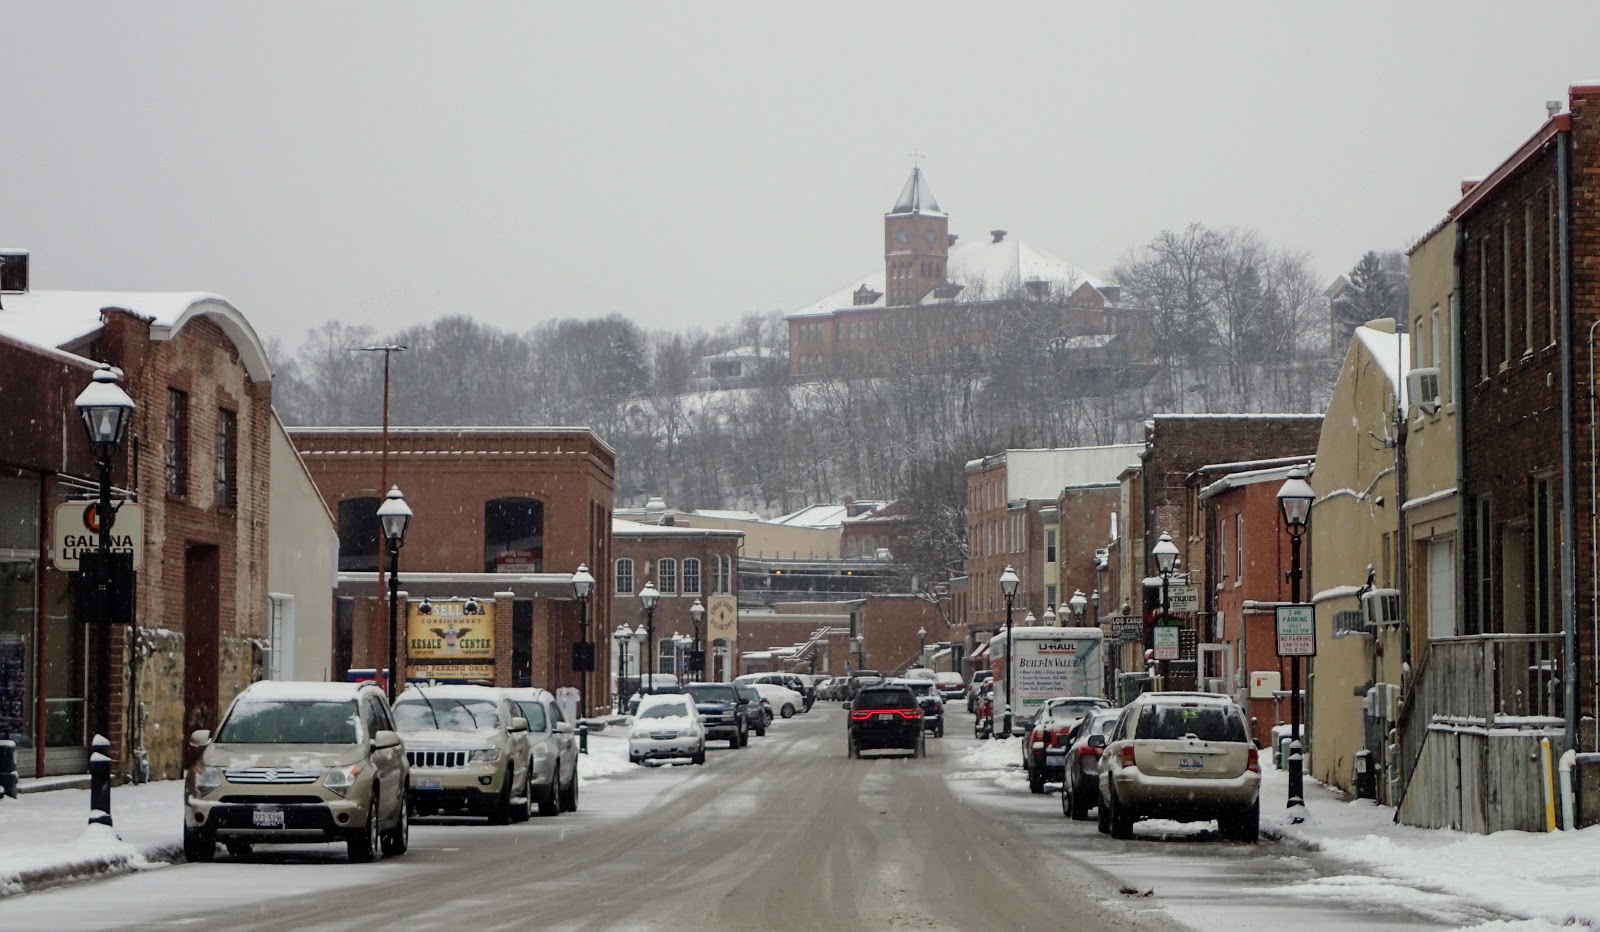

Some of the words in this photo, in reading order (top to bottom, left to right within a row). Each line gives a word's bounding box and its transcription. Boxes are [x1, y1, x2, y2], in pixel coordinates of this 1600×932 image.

[64, 535, 133, 547] GALNA
[1112, 617, 1125, 625] LOG
[411, 639, 442, 649] RESALE
[459, 639, 491, 649] CENTER
